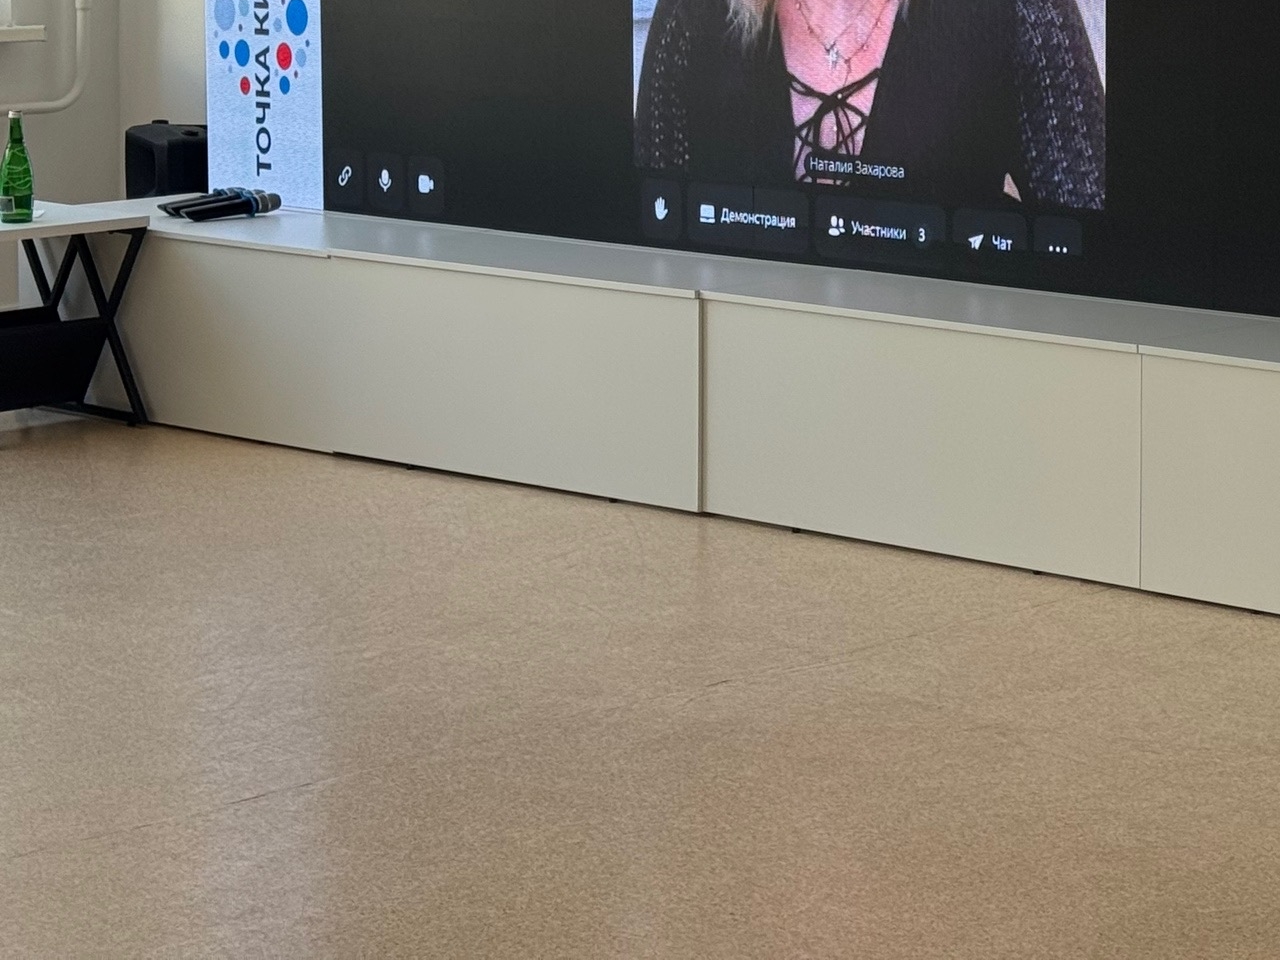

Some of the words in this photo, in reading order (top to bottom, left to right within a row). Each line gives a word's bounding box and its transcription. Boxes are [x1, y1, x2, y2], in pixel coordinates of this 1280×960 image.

[254, 45, 273, 177] ТОЧКА
[809, 156, 854, 174] Наталия
[854, 160, 905, 179] Захарова
[720, 207, 796, 230] Демонстрация
[850, 220, 908, 241] Участники
[917, 227, 927, 243] 3
[991, 234, 1013, 252] Чат
